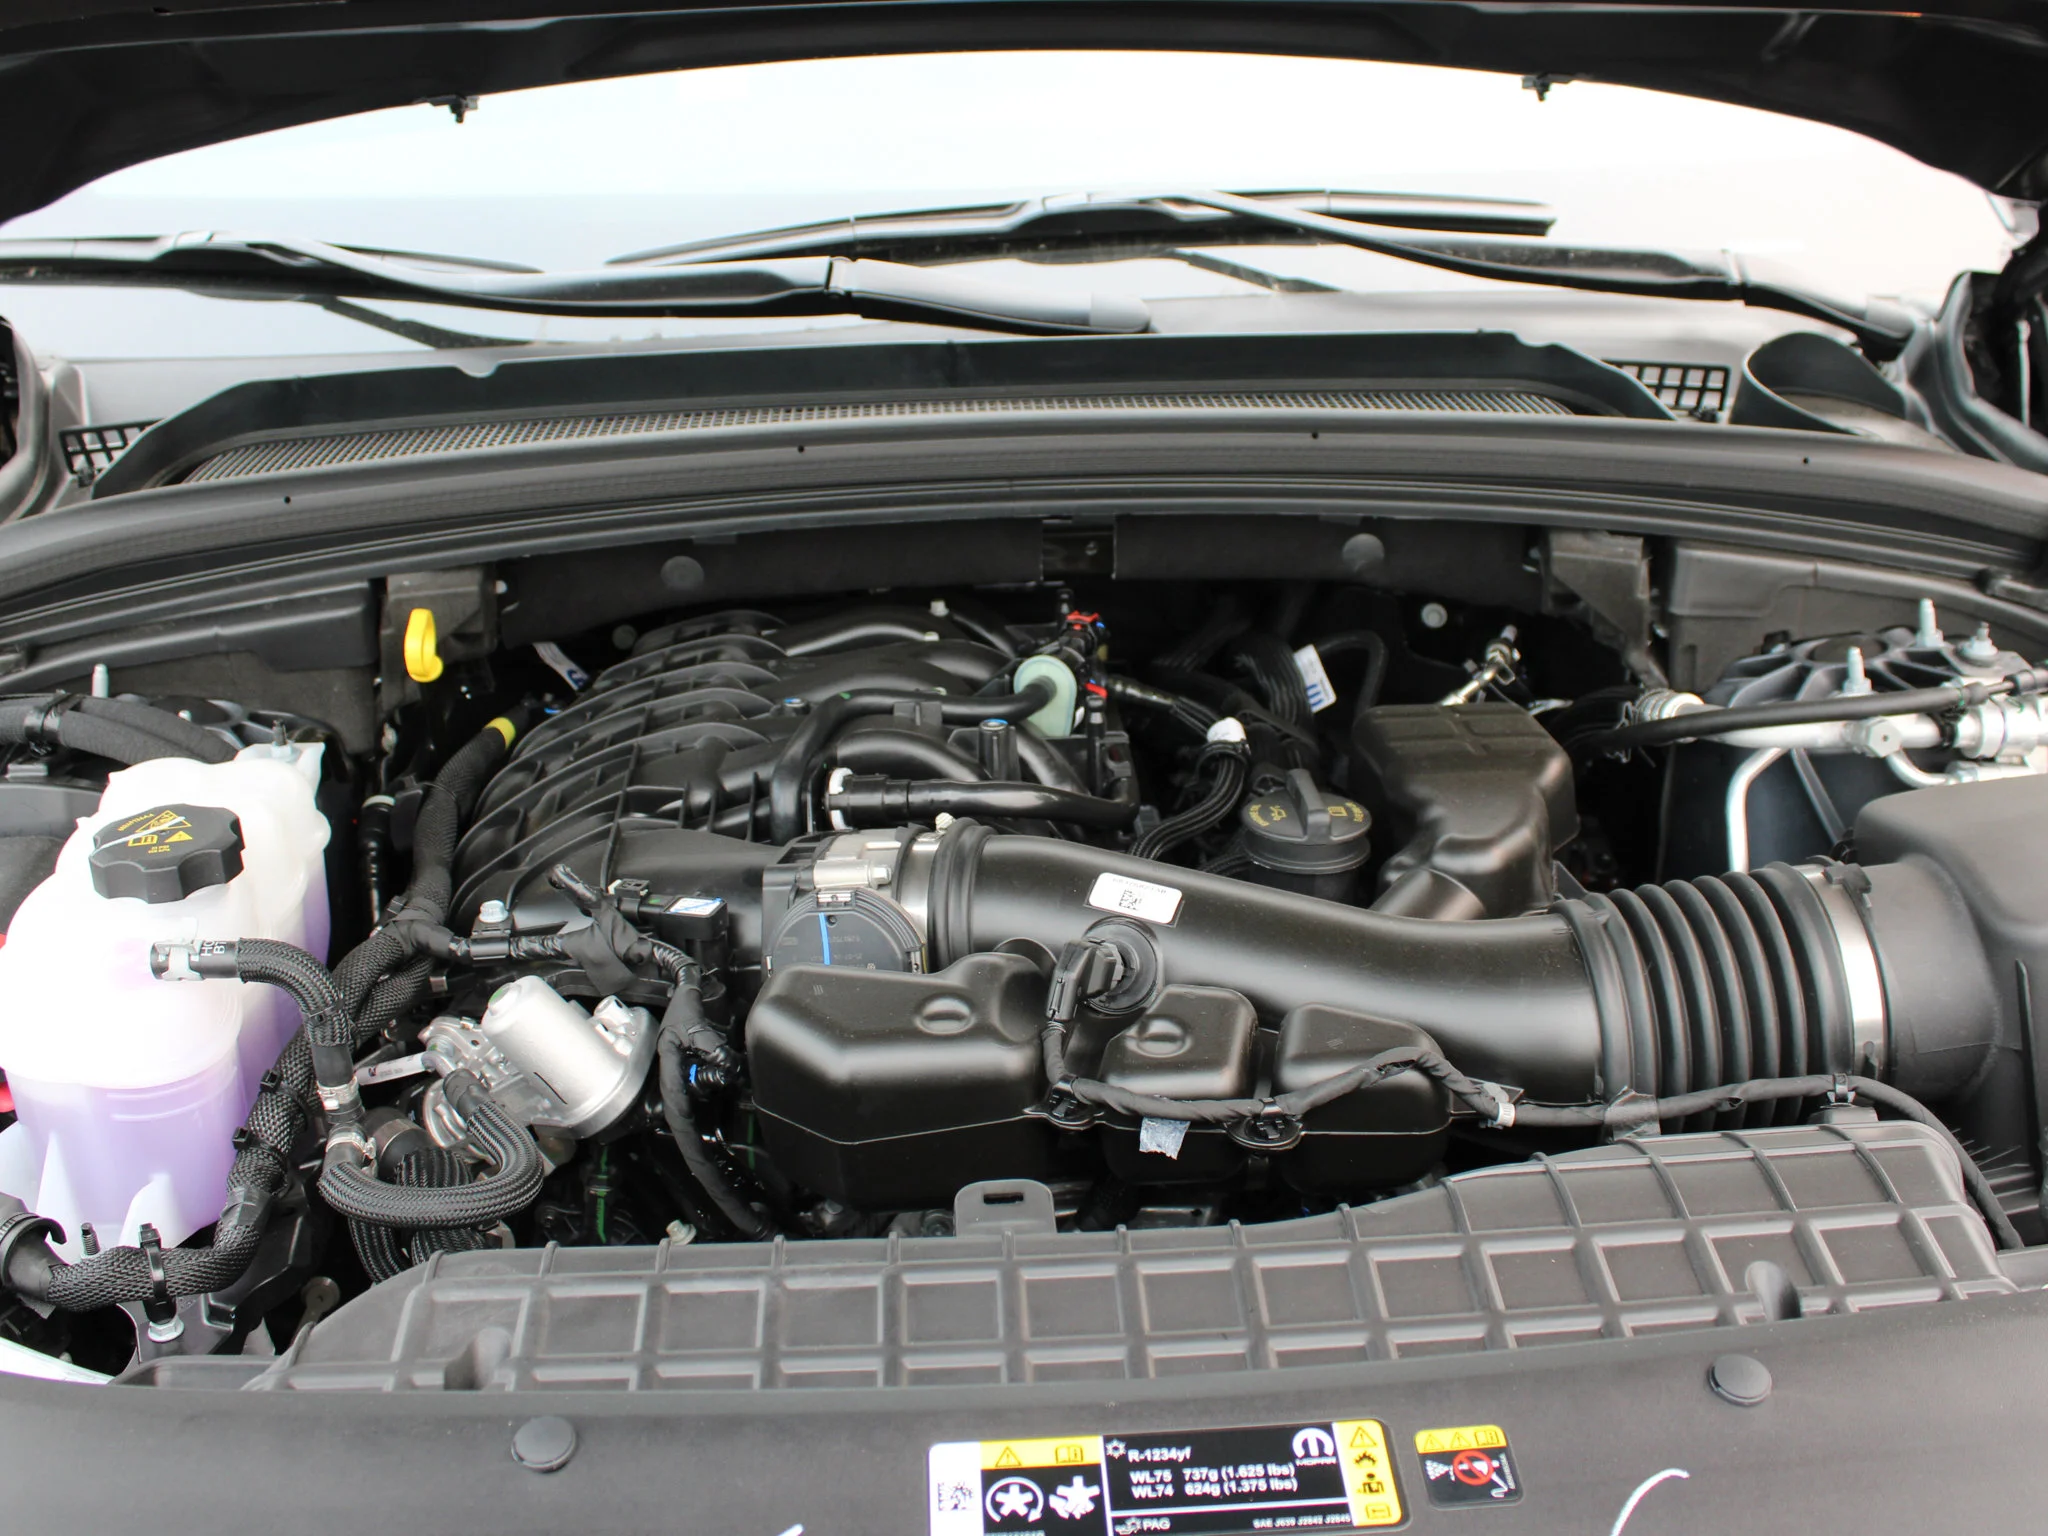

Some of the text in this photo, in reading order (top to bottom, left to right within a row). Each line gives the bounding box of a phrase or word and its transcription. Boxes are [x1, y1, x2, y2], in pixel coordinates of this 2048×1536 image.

[1127, 1446, 1192, 1463] R-1234yf
[1129, 1461, 1295, 1484] WL75 737g (1.625 lbs)
[1131, 1476, 1298, 1499] WL74 624g (1.375 lbs)
[1142, 1517, 1171, 1531] PAG
[1252, 1518, 1273, 1529] SAE
